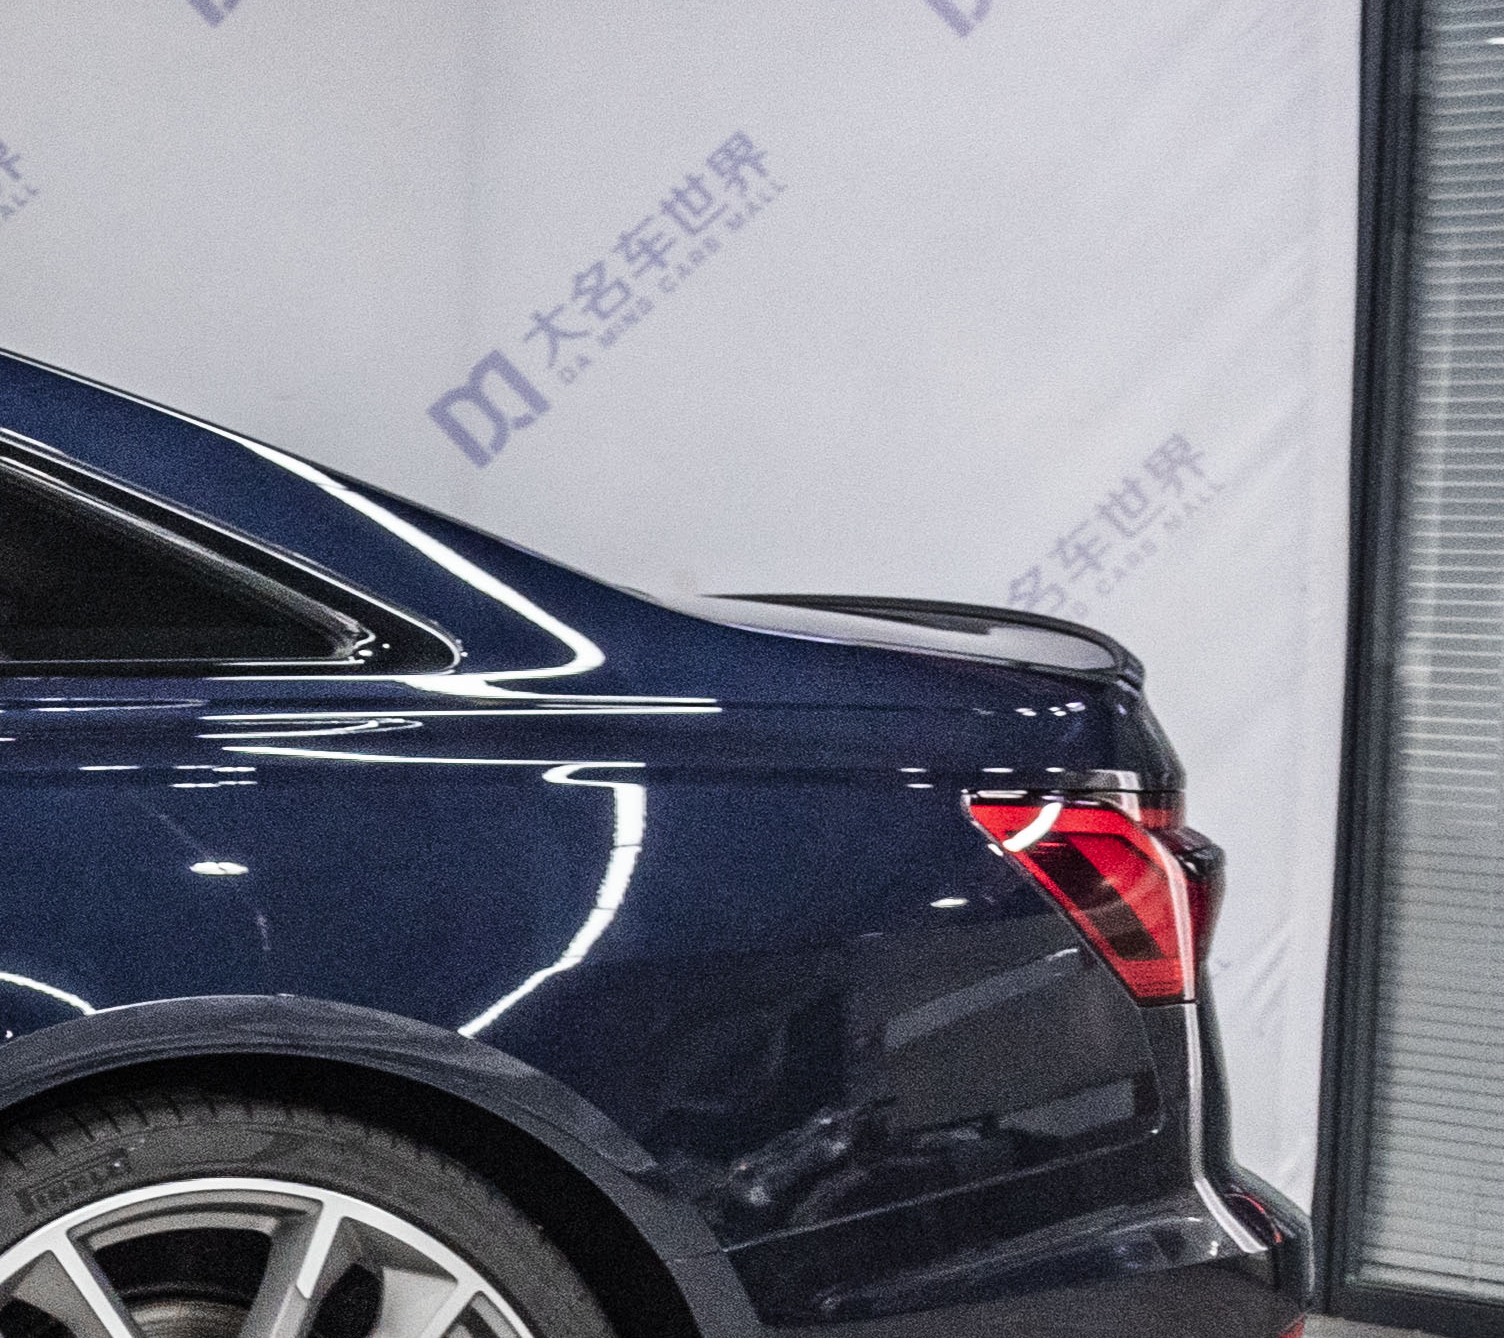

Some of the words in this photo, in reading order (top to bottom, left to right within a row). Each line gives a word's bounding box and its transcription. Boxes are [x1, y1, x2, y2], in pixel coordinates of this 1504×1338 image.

[522, 130, 770, 371] 大名车世界
[1007, 433, 1205, 611] 名车世界
